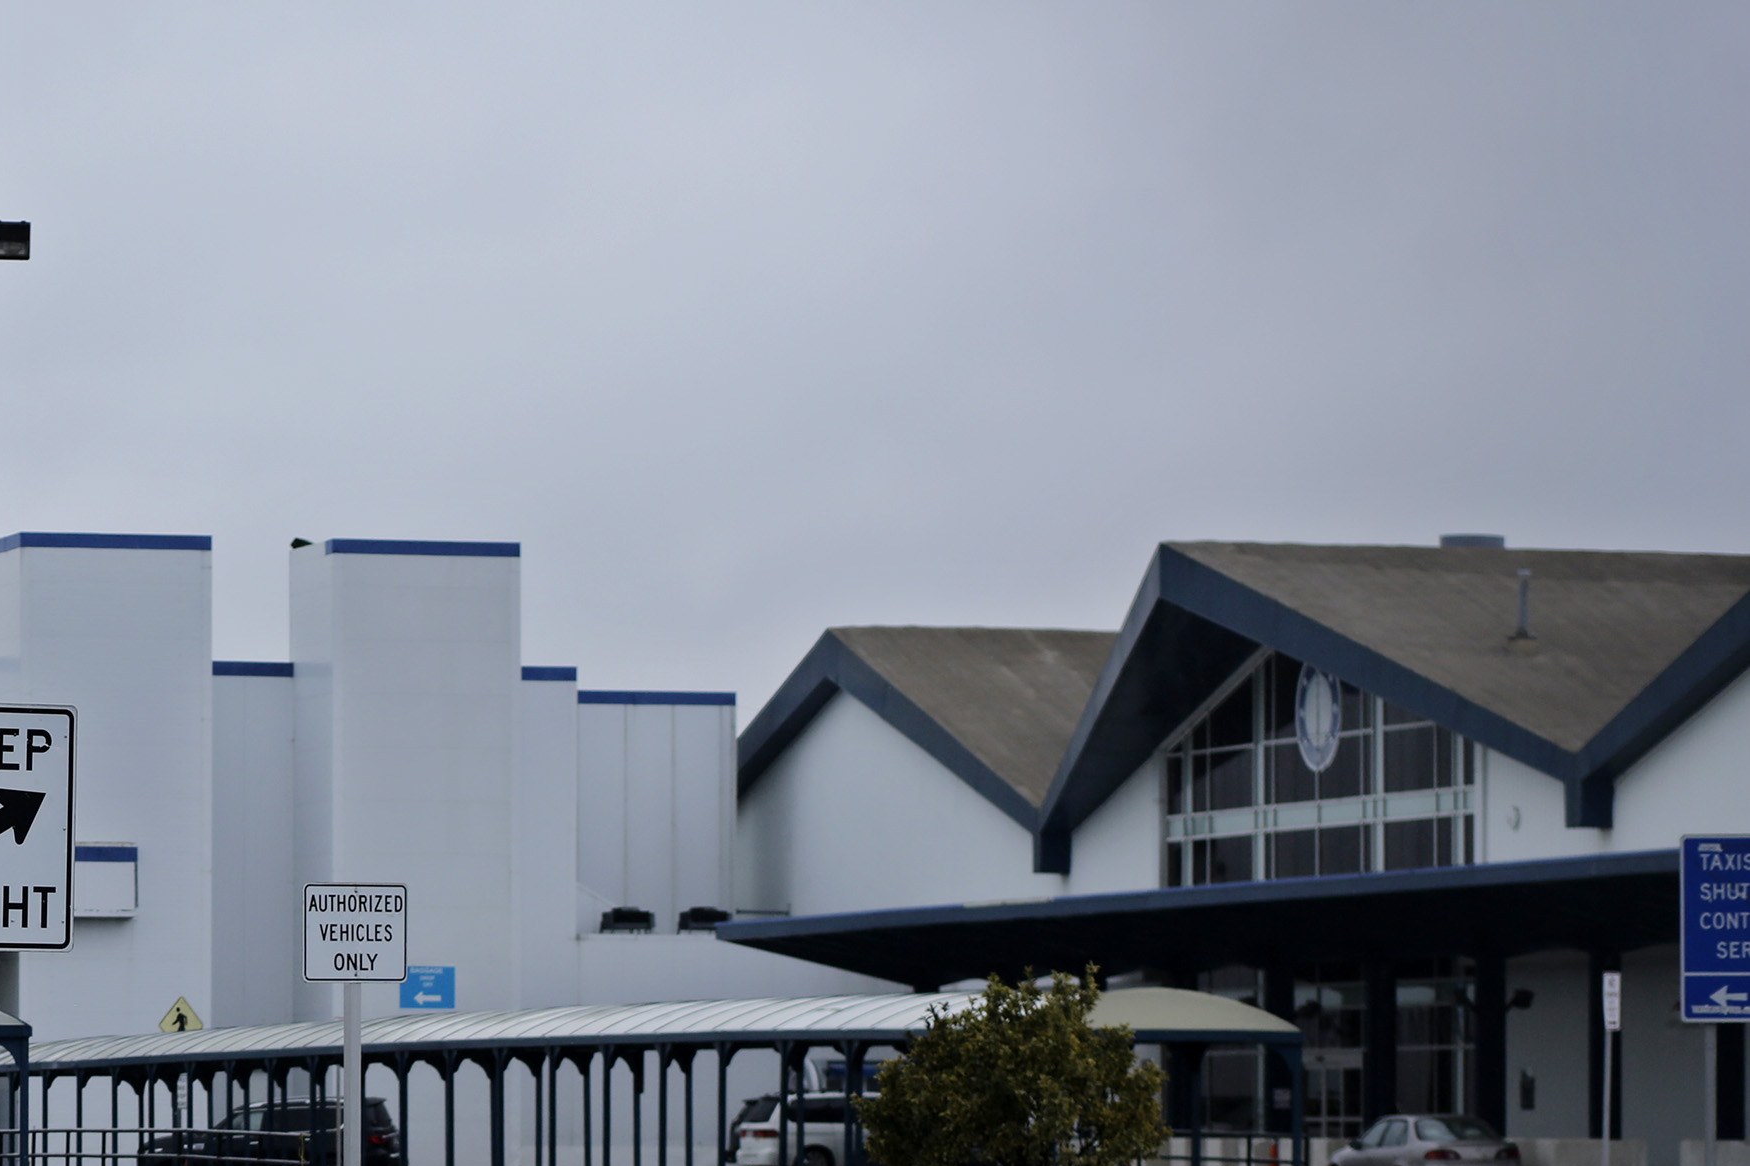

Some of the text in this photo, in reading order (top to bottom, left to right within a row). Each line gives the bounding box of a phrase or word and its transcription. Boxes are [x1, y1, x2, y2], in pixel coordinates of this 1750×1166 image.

[308, 894, 403, 913] AUTHORIZED
[1700, 912, 1750, 930] CONT
[319, 923, 393, 942] VEHICLES
[333, 952, 378, 971] ONLY
